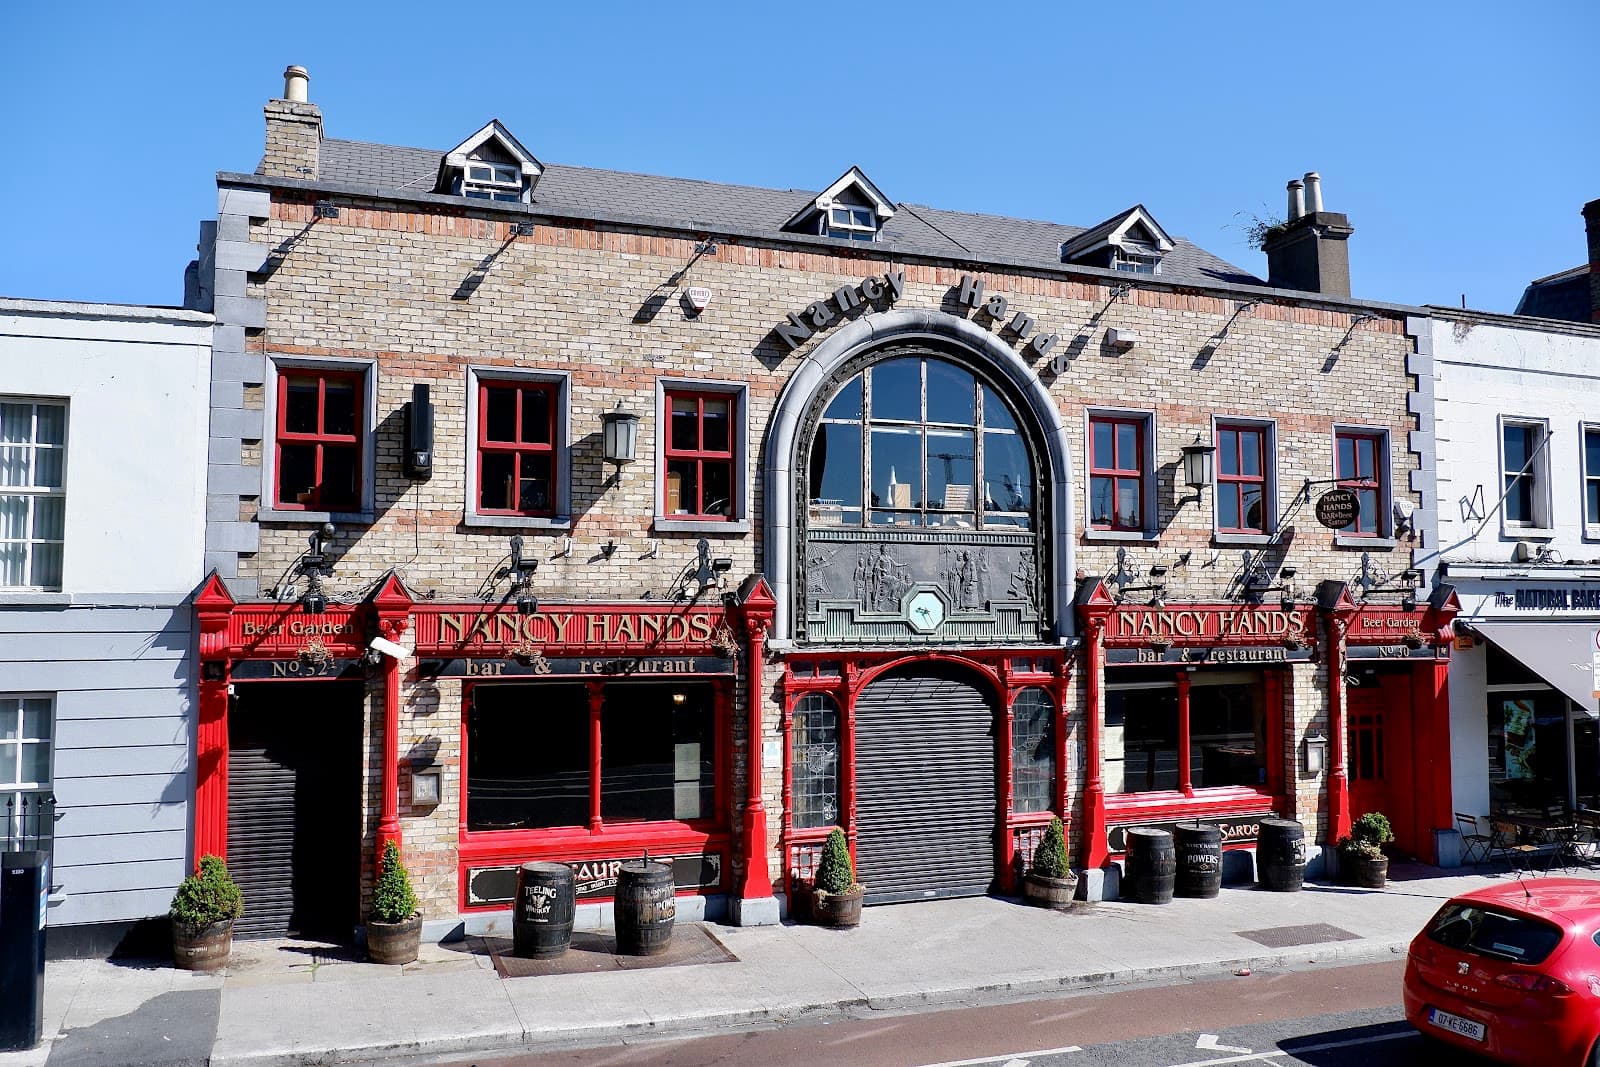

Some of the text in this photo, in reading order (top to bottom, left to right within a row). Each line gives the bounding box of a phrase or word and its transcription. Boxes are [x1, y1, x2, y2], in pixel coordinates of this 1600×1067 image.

[774, 271, 1071, 376] Nancy Hands
[1323, 494, 1352, 502] NANCY
[1322, 502, 1353, 511] HANDS
[1495, 592, 1513, 608] The
[1515, 589, 1571, 611] NATURAL
[244, 621, 354, 635] Beer Garden
[438, 614, 712, 642] NANCY HANDS
[1119, 611, 1305, 636] NANCY HANDS
[1363, 617, 1420, 628] Beer Garden
[1138, 647, 1288, 663] bar & restaurant
[466, 656, 697, 676] bar & restaurant
[1187, 854, 1219, 864] POWERS
[525, 885, 557, 899] TEELING
